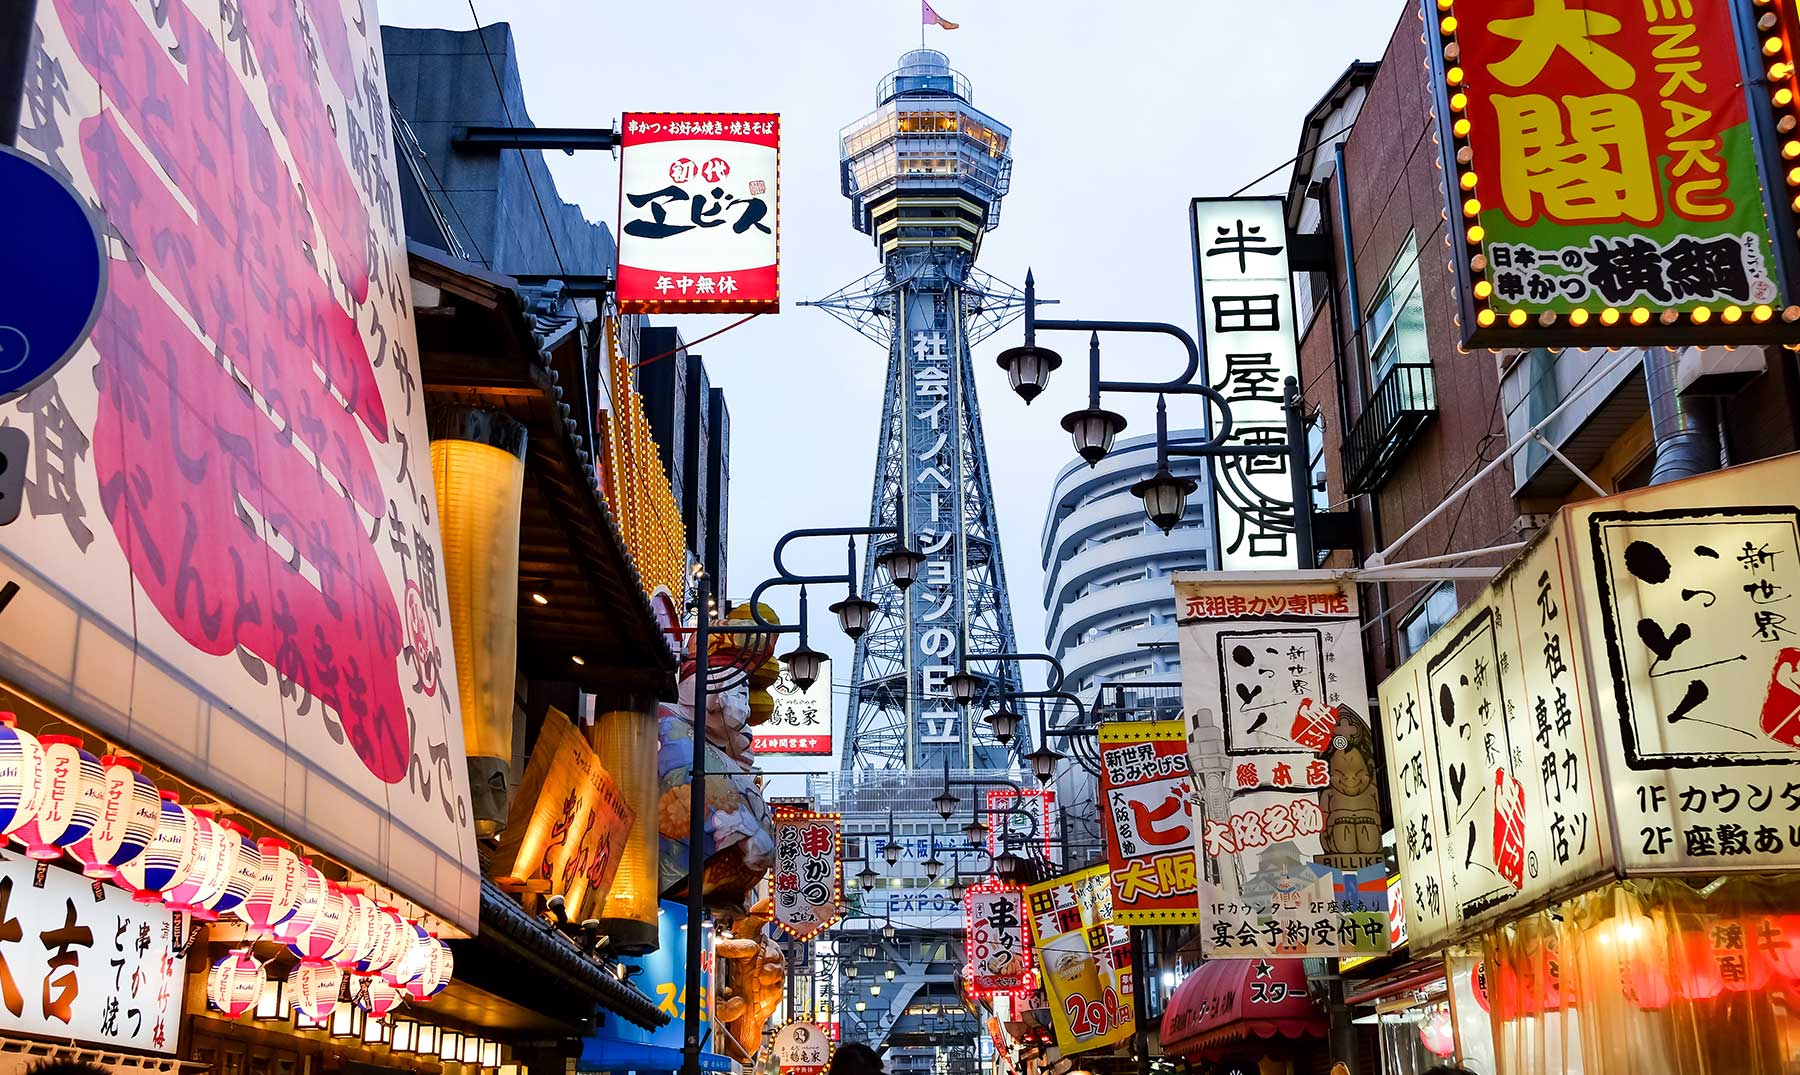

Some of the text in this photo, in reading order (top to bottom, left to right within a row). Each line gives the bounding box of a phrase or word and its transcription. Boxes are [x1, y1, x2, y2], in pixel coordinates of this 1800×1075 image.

[654, 275, 738, 296] 年中無休
[1493, 246, 1583, 268] 日本一の
[1497, 273, 1587, 300] 串かつ
[1584, 237, 1750, 302] 横綱
[1205, 218, 1290, 558] 半田屋酒店
[912, 331, 961, 744] 社会イノベーションの日立
[1186, 594, 1349, 619] 元祖串カツ専門店
[1736, 541, 1797, 643] 新世界
[1286, 645, 1313, 696] 新世界
[754, 738, 817, 749] 24時間営業中
[1474, 657, 1500, 769] 新世界
[1105, 743, 1155, 768] 新世界
[1109, 755, 1189, 784] おみやげS
[1236, 760, 1329, 787] 総本店
[46, 756, 70, 822] アサヒビール
[99, 779, 126, 842] アサヒビール
[1111, 791, 1136, 856] 大阪名物
[1203, 799, 1327, 858] 大阪名物
[279, 856, 295, 907] アサヒビール
[778, 825, 799, 907] お好み焼き
[801, 824, 832, 906] 串かつ
[1114, 853, 1198, 902] 大阪
[987, 896, 1020, 969] 串かつ
[1211, 918, 1385, 948] 宴会予約受付中
[100, 914, 132, 1037] どて焼
[127, 921, 152, 1039] 串かつ
[152, 944, 174, 1050] 松竹梅
[1250, 982, 1307, 1003] スター
